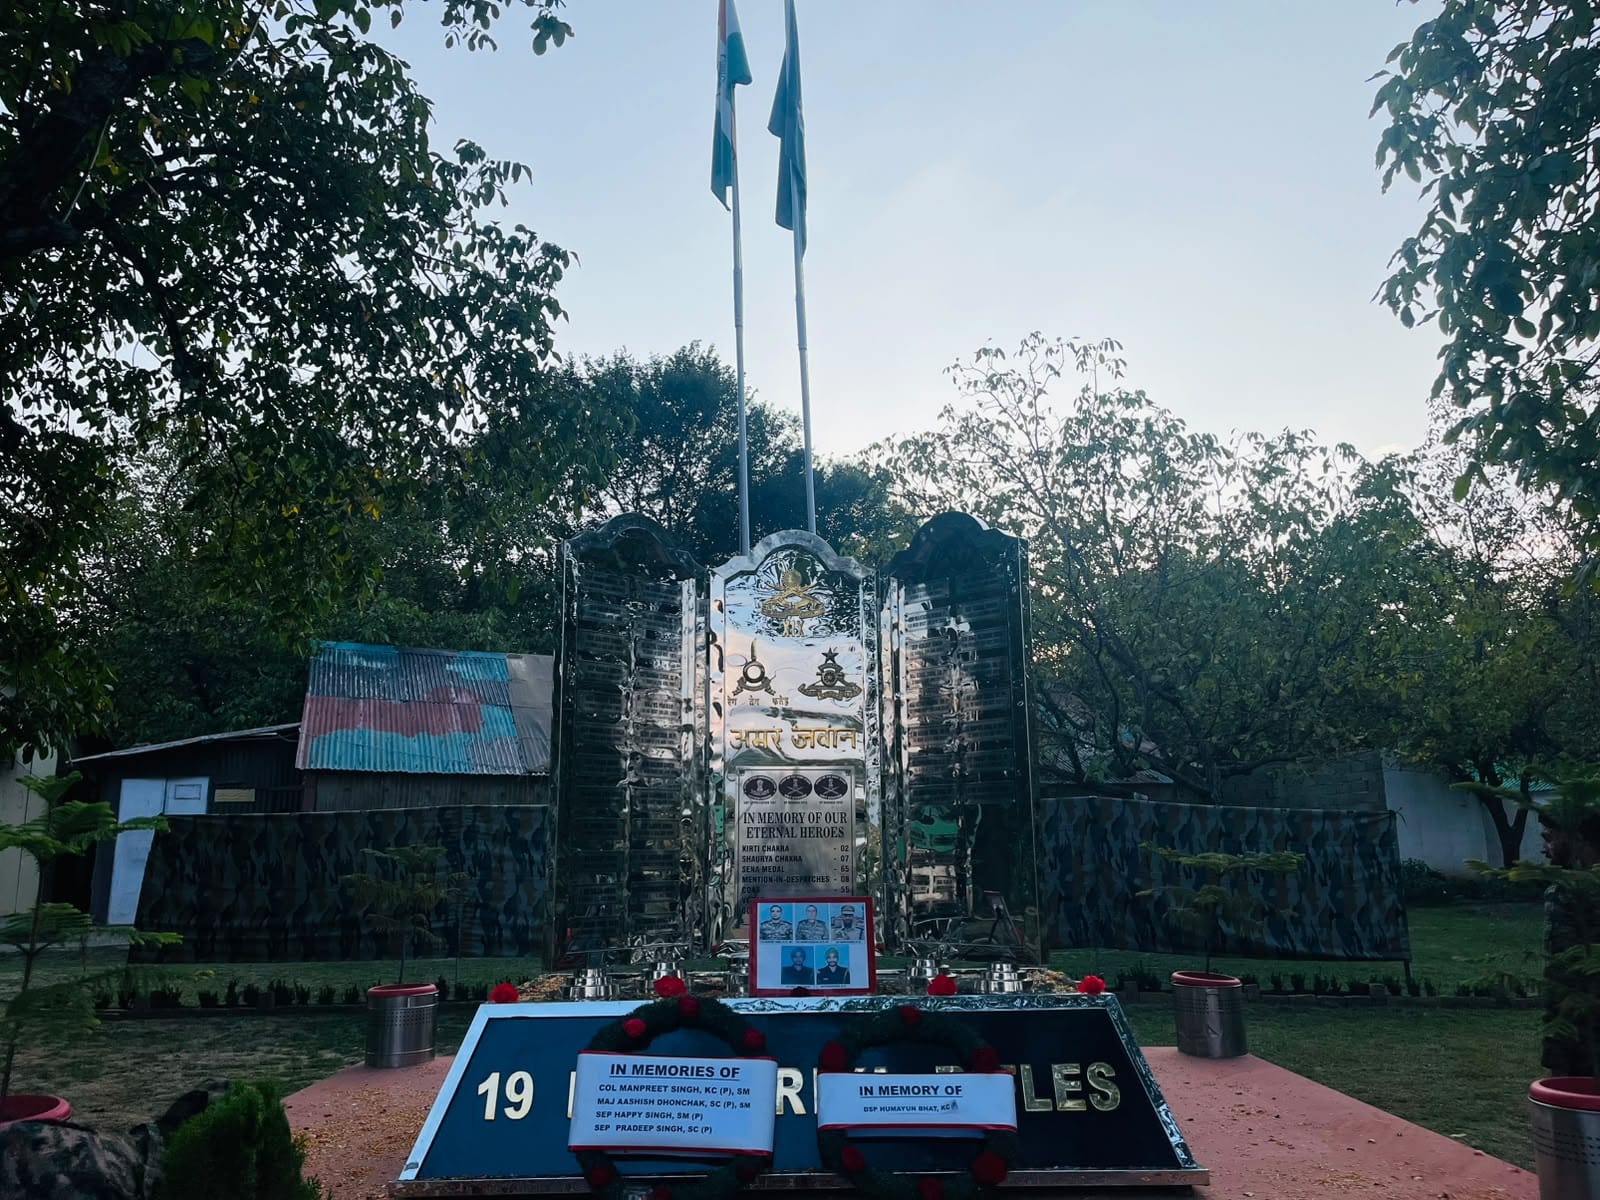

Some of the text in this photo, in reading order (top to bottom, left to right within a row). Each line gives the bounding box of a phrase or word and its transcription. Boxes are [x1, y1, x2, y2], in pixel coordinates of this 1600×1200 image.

[730, 727, 857, 750] अमर जवान
[743, 811, 848, 824] IN MEMORY OF OUR
[746, 826, 845, 839] ETERNAL HEROES
[610, 1064, 741, 1078] IN MEMORIES OF
[477, 1070, 534, 1120] 19
[599, 1084, 617, 1092] COL
[619, 1084, 668, 1093] MANPREET
[671, 1086, 702, 1094] SINGH,
[719, 1087, 735, 1096] (P),
[859, 1085, 963, 1096] IN MEMORY OF
[657, 1099, 708, 1107] DHONCHAK,
[723, 1101, 738, 1109] (P),
[918, 1105, 939, 1113] BHAT,
[614, 1111, 643, 1119] HAPPY
[645, 1112, 675, 1120] SINGH,
[692, 1113, 703, 1121] (P)
[656, 1125, 686, 1134] SINGH,
[701, 1126, 713, 1135] (P)
